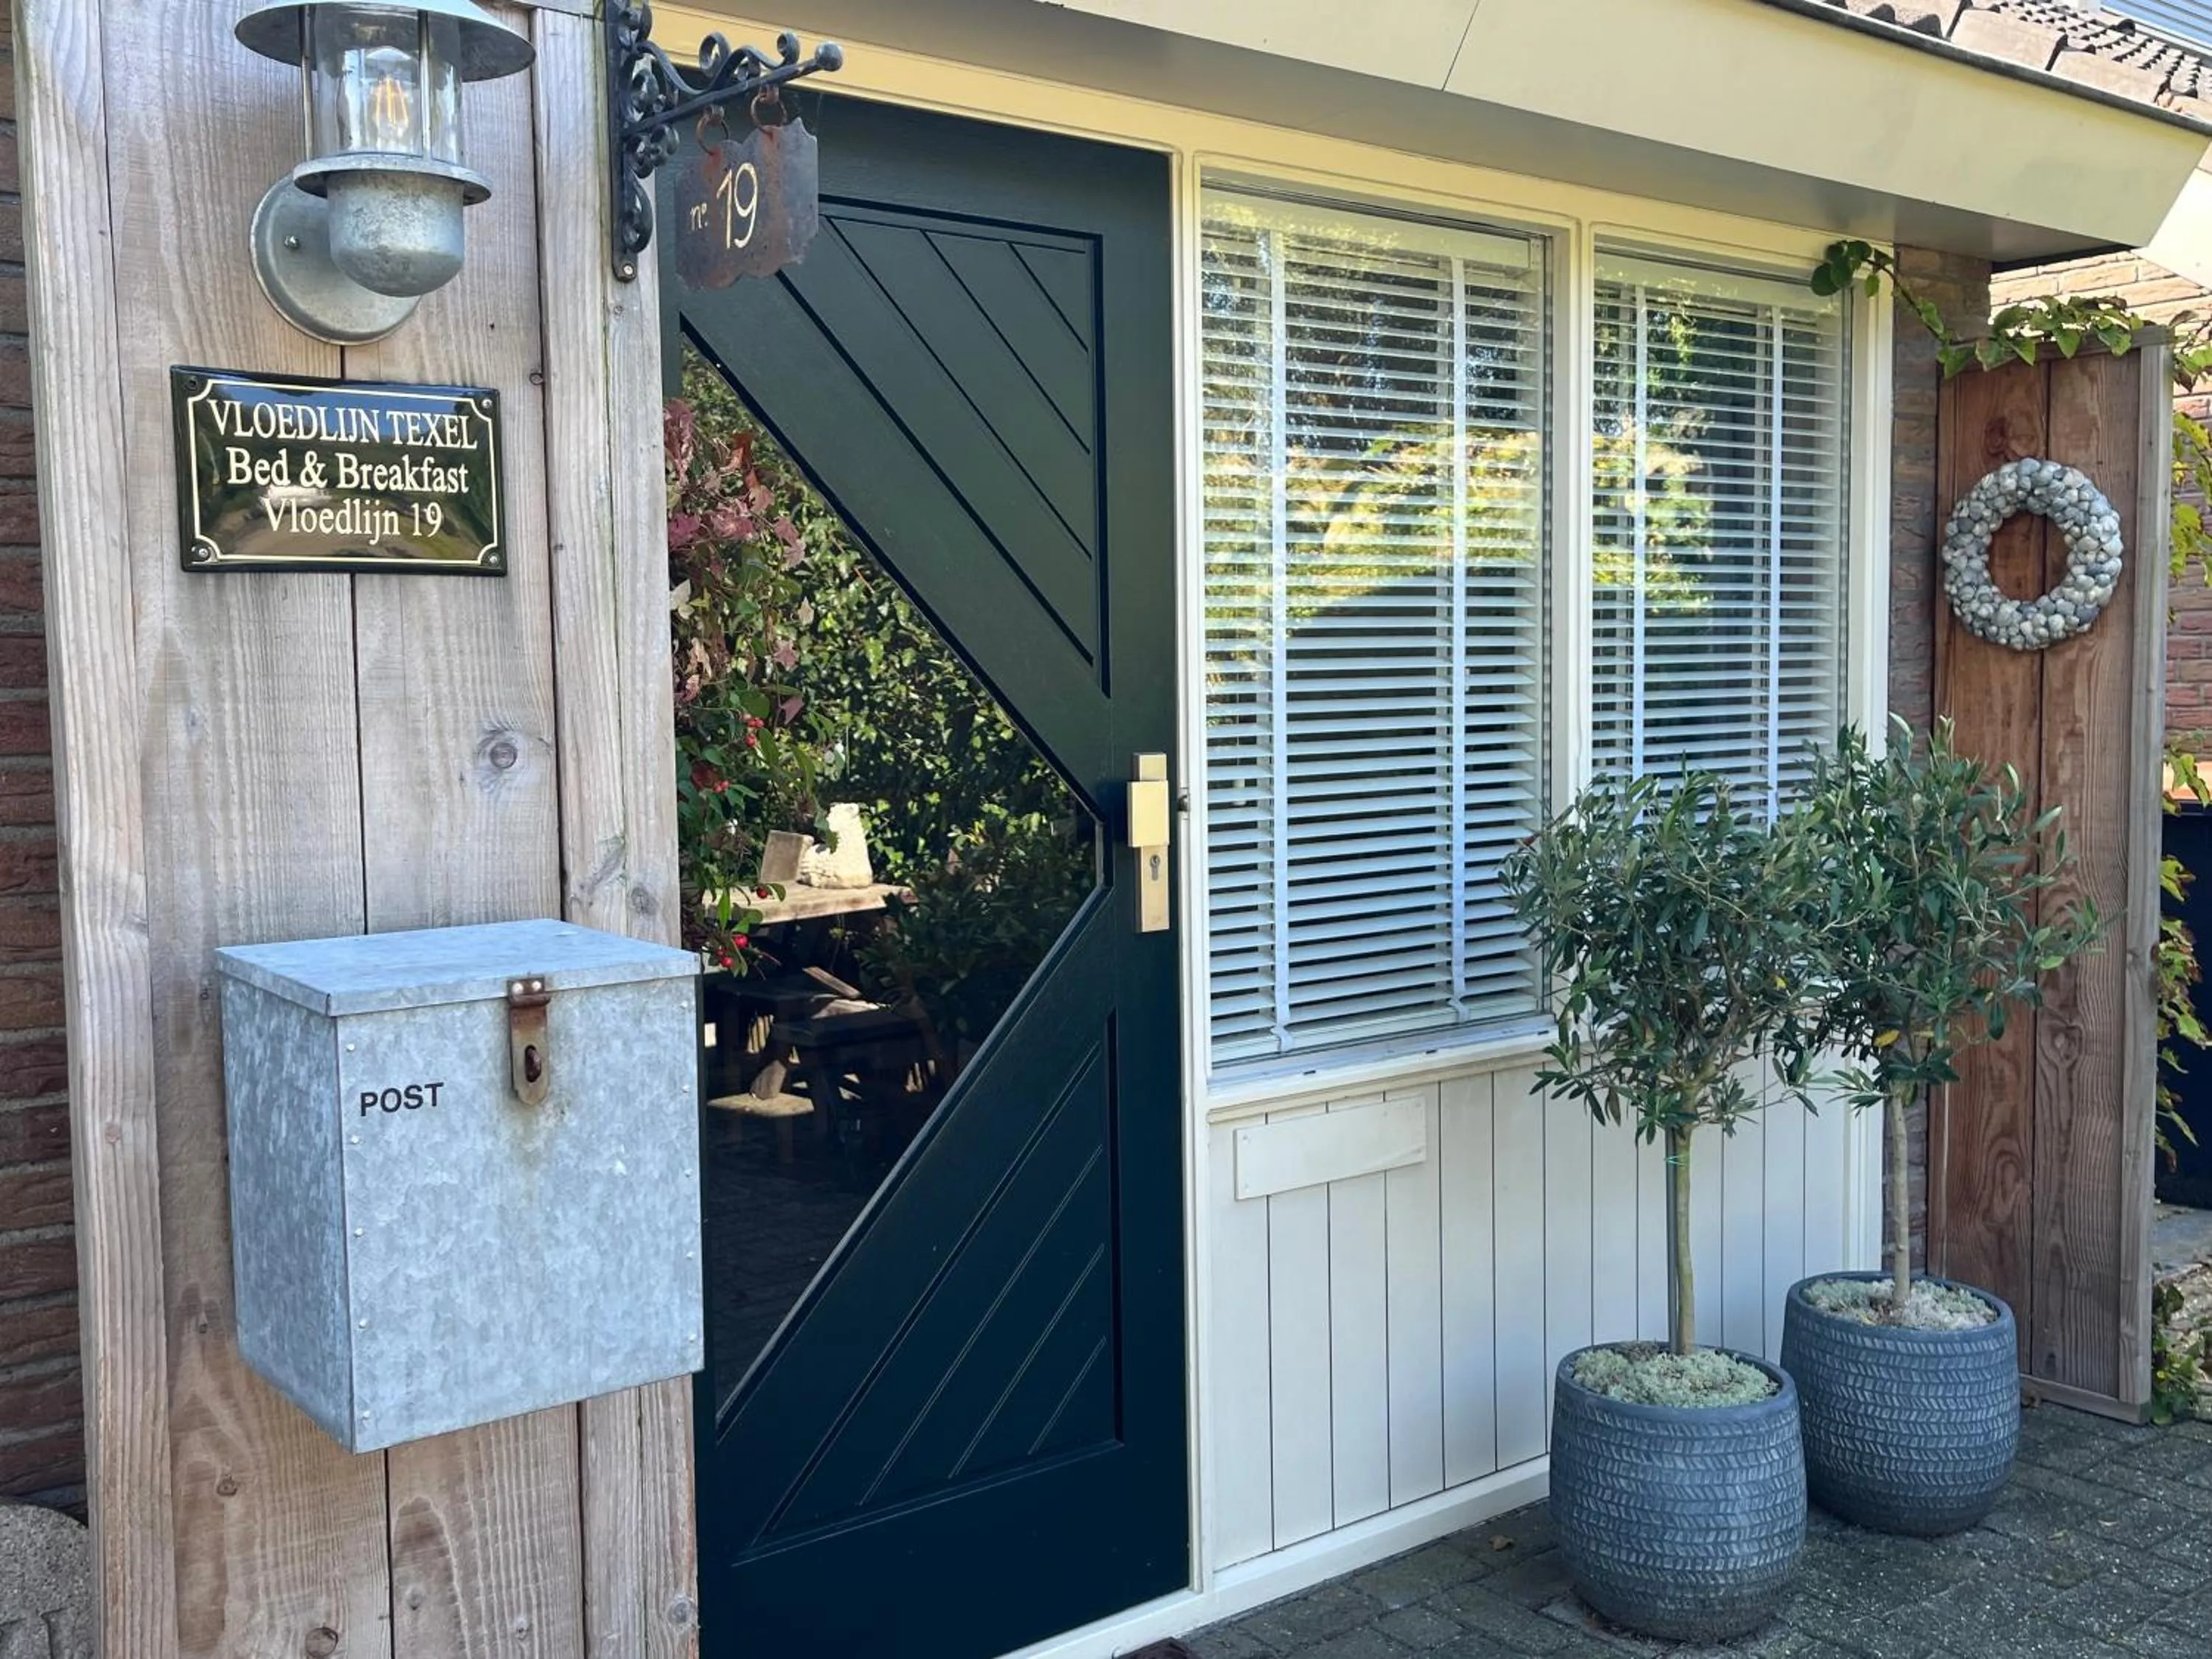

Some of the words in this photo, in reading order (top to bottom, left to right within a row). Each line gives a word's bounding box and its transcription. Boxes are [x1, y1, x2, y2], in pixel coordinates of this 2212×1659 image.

[716, 162, 758, 248] 19
[206, 399, 380, 443] VLOEDLIJN
[386, 411, 478, 450] TEXEL
[226, 446, 291, 487] Bed
[299, 450, 328, 488] &
[335, 452, 470, 493] Breakfast
[262, 497, 401, 546] Vloedlijn
[411, 502, 443, 538] 19
[360, 1082, 445, 1117] POST
